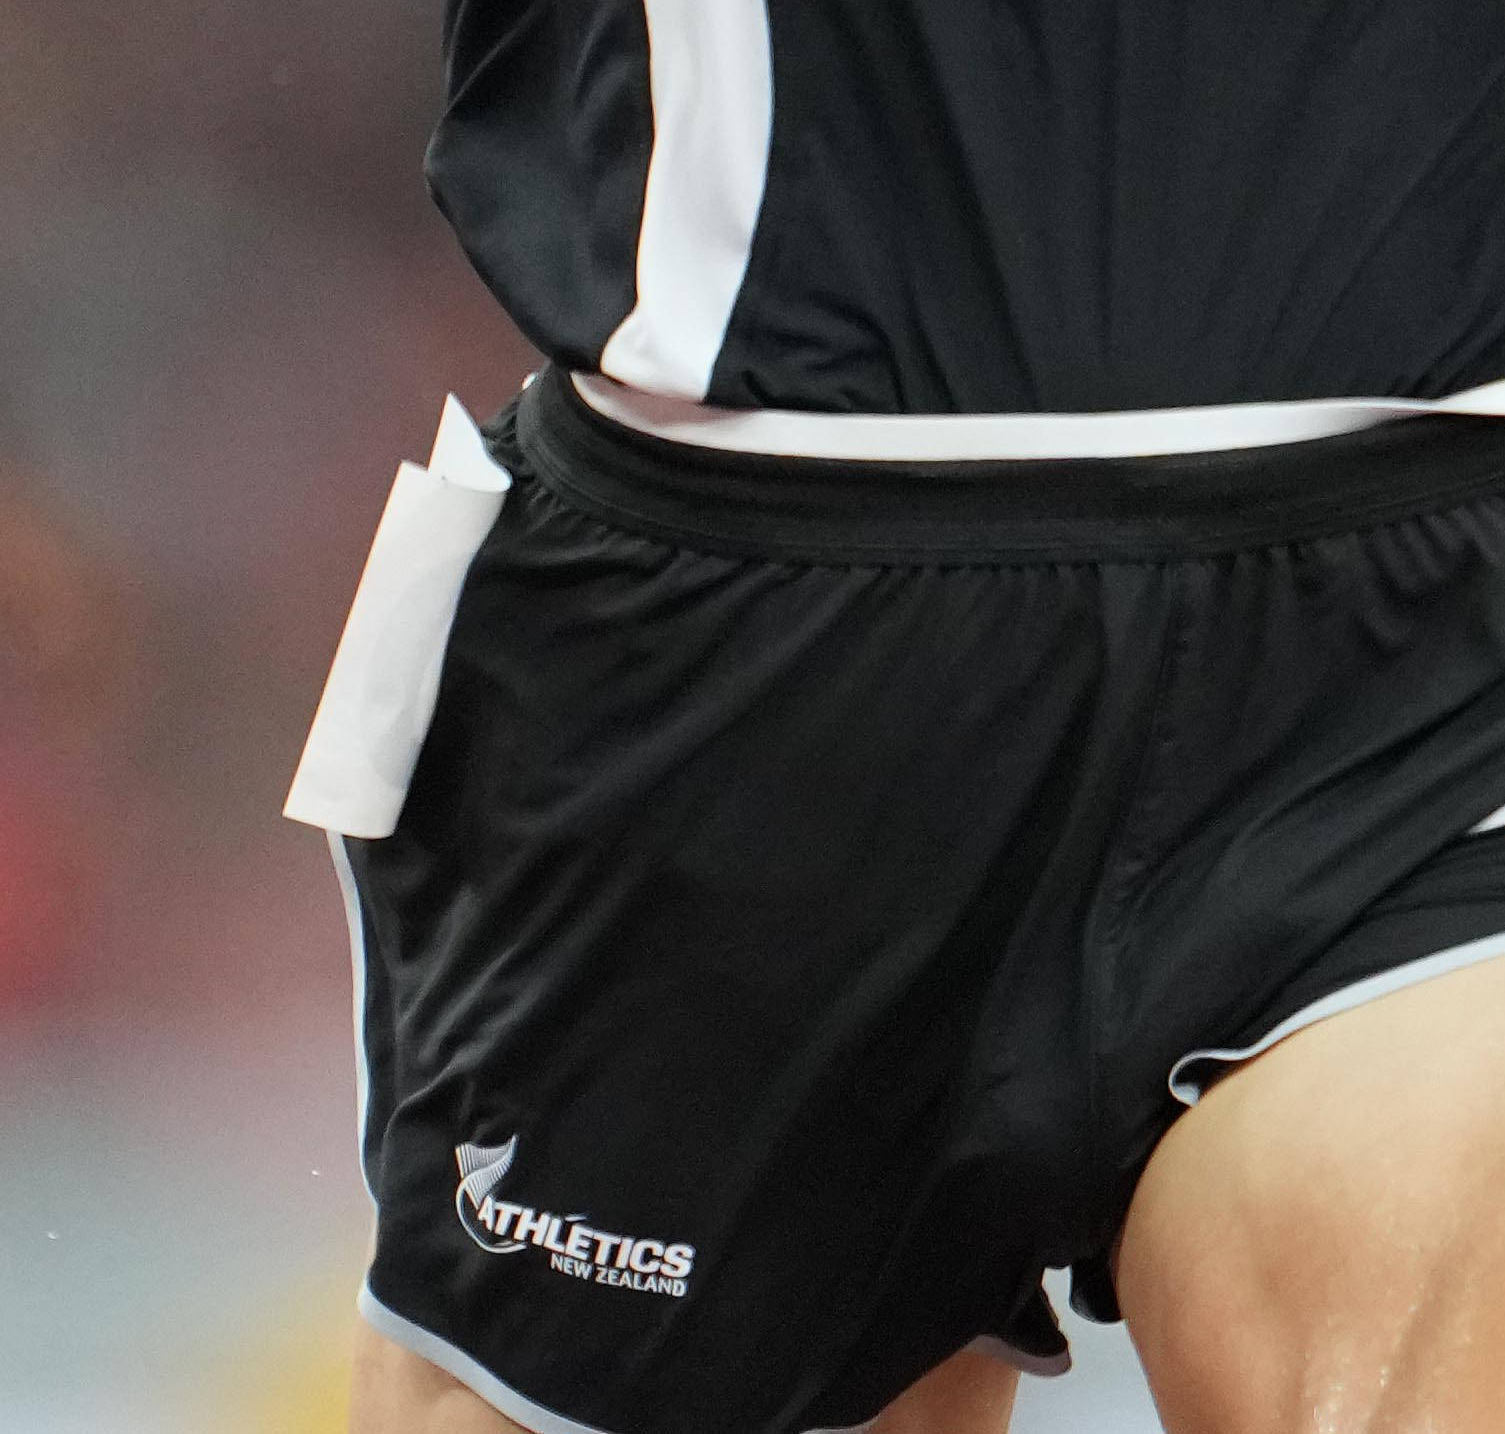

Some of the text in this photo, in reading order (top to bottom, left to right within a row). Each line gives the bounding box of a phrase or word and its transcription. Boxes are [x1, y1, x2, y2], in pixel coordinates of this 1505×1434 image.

[477, 1194, 695, 1279] ATHLETICS
[550, 1252, 689, 1298] NEW ZEALAND
